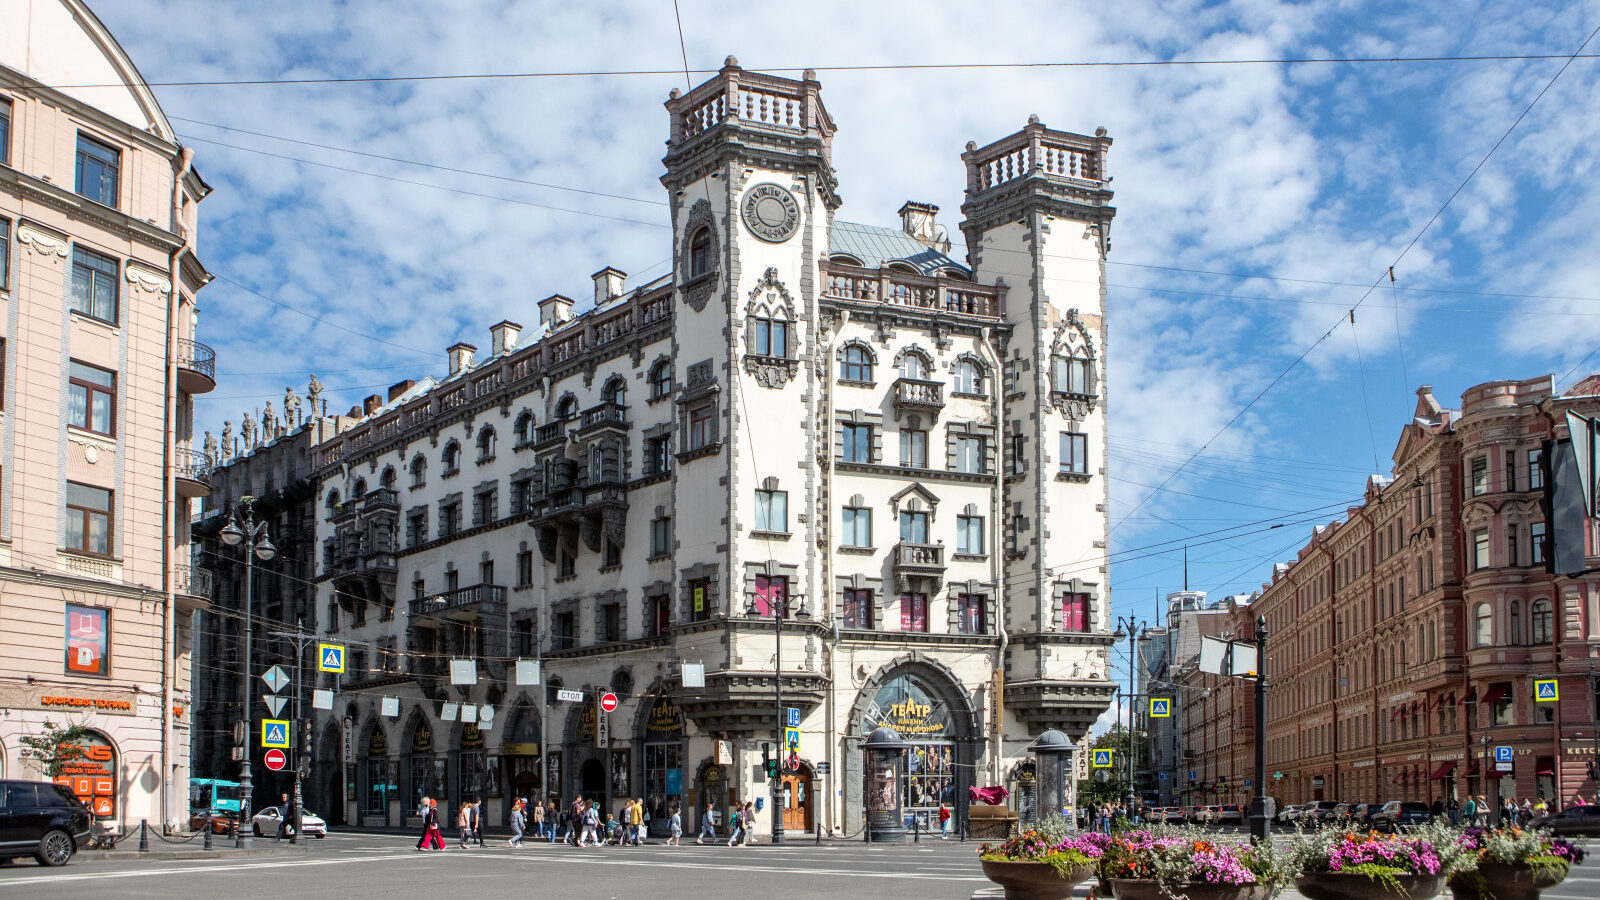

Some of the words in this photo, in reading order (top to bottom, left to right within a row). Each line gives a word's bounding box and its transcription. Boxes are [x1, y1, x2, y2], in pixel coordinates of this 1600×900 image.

[41, 696, 92, 706] ЦИФРОВАЯ
[94, 699, 131, 711] ТЕХНИКА
[561, 691, 581, 701] СТОП
[652, 701, 679, 718] ТЕАТР
[891, 698, 931, 718] ТЕАТР
[906, 723, 944, 733] МИРОНОВА
